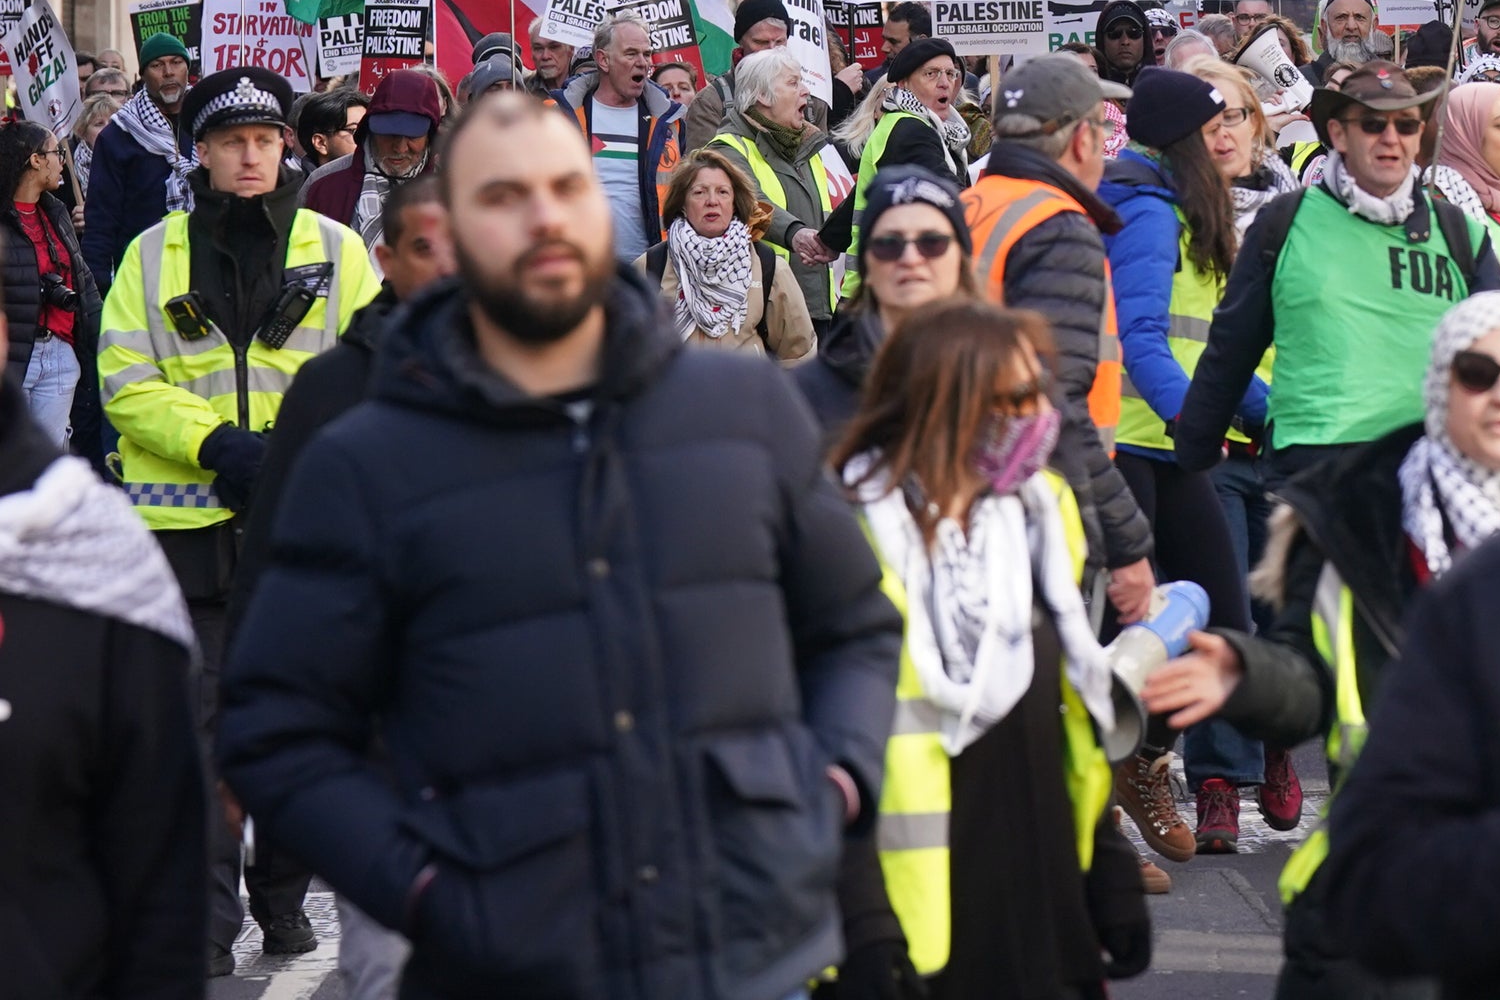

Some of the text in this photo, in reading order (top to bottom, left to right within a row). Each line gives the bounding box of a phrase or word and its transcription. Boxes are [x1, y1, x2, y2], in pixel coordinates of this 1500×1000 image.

[138, 1, 164, 11] Socialist
[259, 2, 278, 13] IN
[936, 1, 1044, 22] PALESTINE
[137, 6, 192, 27] FROM THE
[213, 12, 313, 38] STARVATION
[369, 9, 422, 29] FREEDOM
[550, 11, 566, 22] END
[14, 6, 55, 68] HANDS
[140, 22, 188, 41] RIVER TO
[320, 27, 364, 47] PALE
[386, 26, 397, 36] for
[650, 25, 693, 50] STINE
[788, 17, 825, 50] rael
[938, 22, 1043, 34] END ISRAELI OCCUPATION
[324, 46, 363, 58] END ISRA
[365, 36, 423, 56] PALESTINE
[213, 44, 307, 78] TERROR
[28, 51, 68, 107] GAZA!
[1388, 246, 1455, 300] FOA
